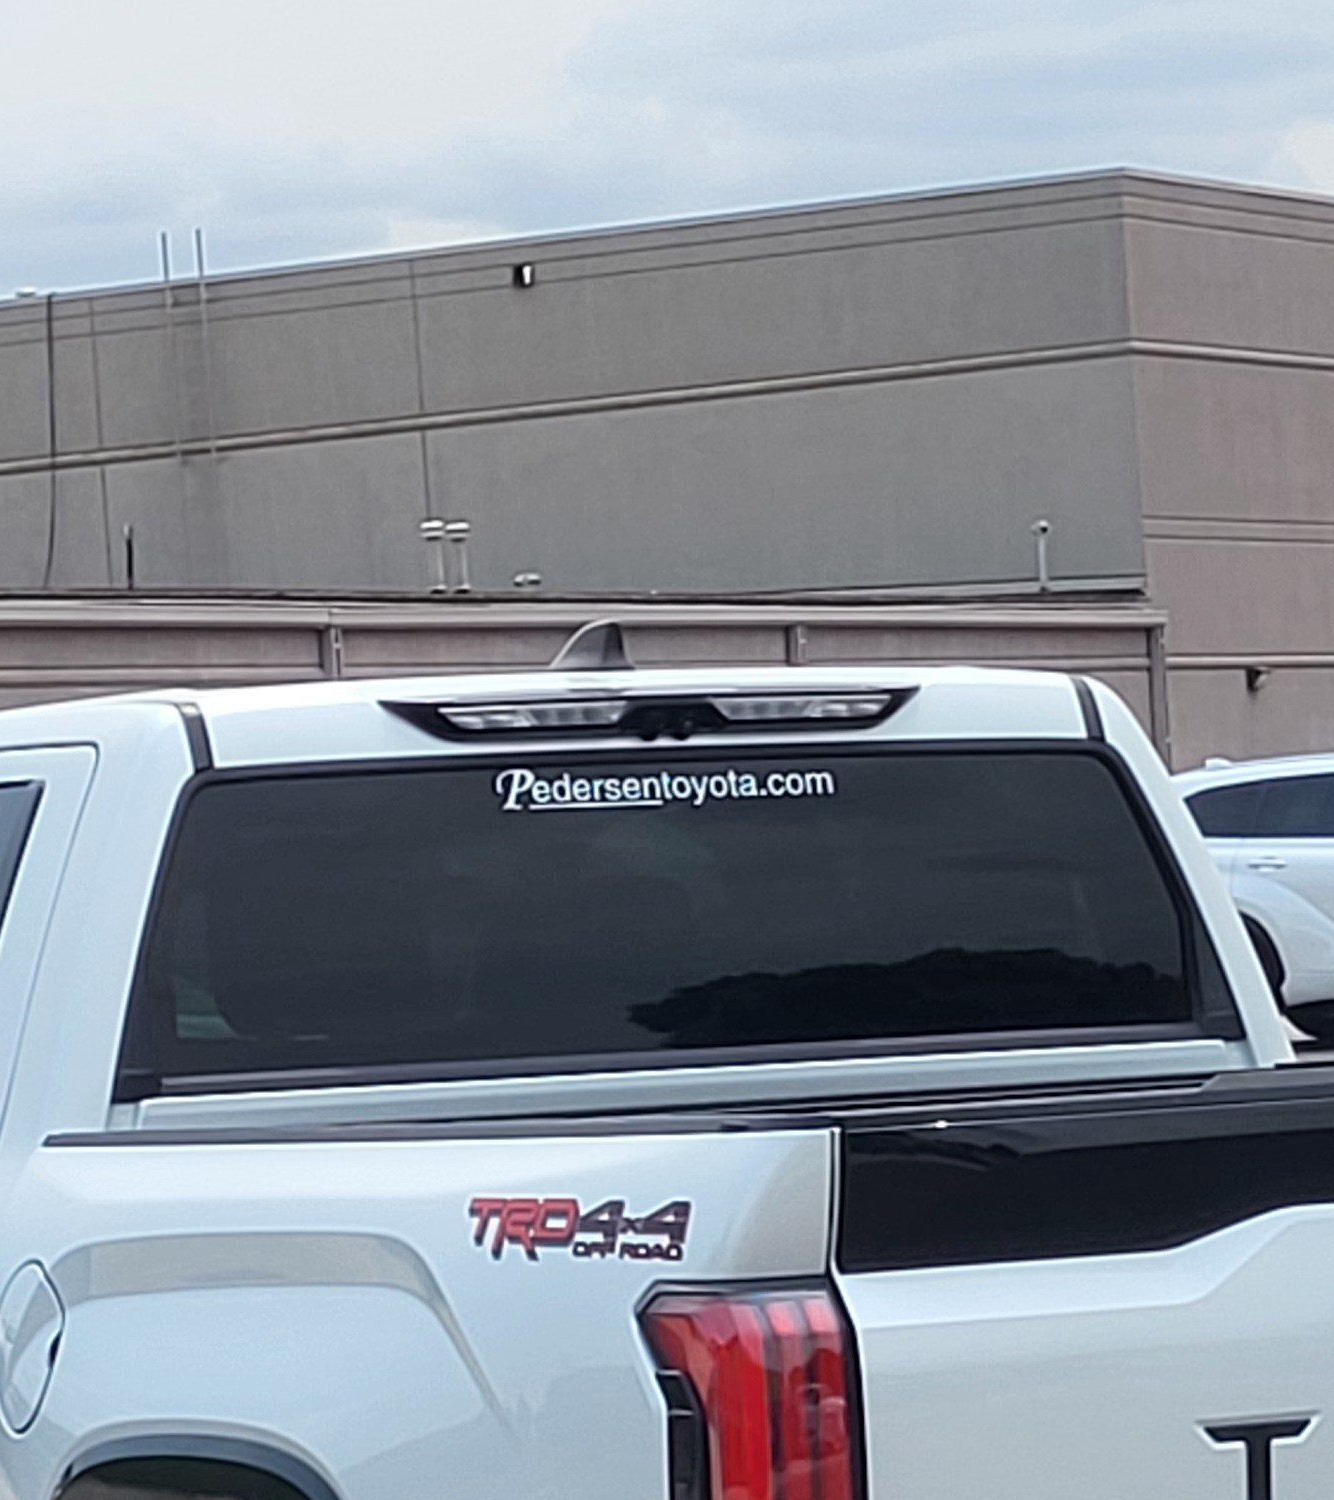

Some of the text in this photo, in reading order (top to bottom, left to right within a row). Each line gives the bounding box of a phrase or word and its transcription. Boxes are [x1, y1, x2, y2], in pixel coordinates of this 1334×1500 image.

[496, 768, 835, 811] Pedersentoyota.com
[469, 1198, 578, 1261] TRD
[572, 1242, 684, 1261] OFF ROAD
